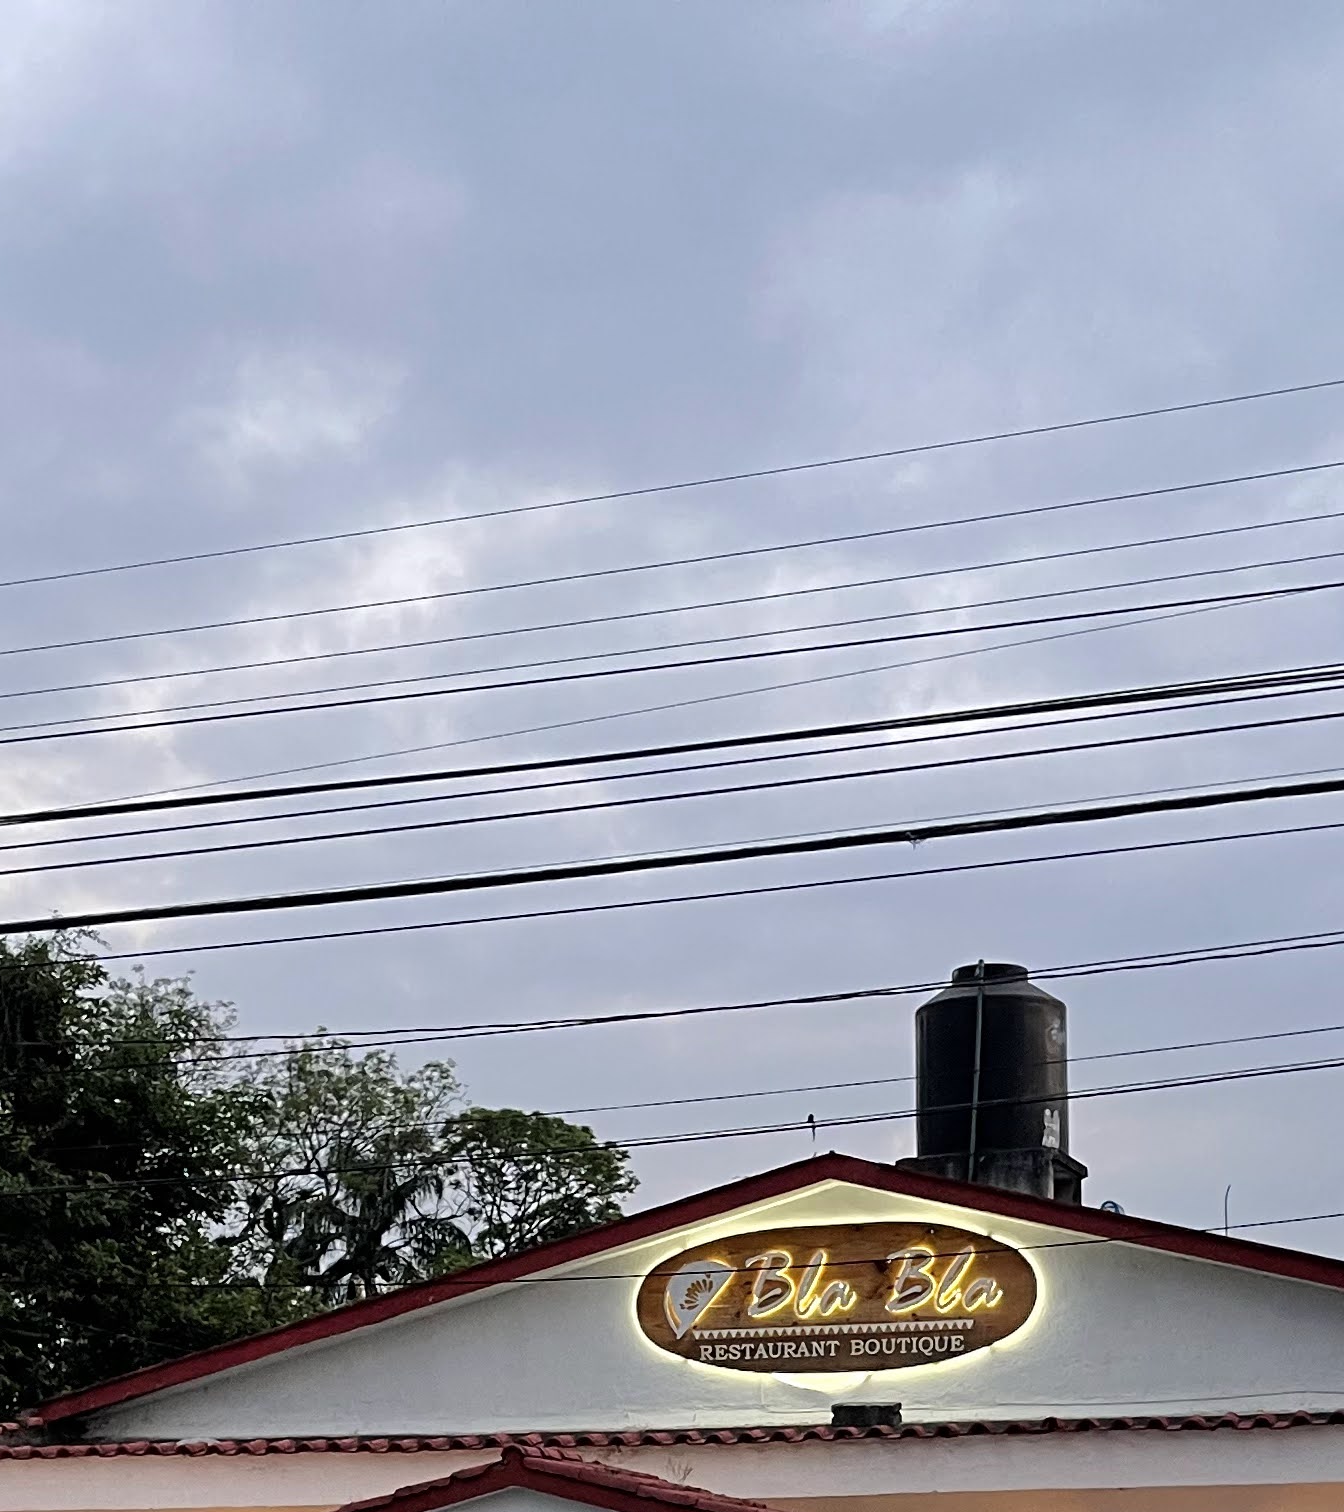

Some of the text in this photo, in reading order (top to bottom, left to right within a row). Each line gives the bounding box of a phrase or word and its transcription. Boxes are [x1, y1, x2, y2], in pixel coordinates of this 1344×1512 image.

[744, 1245, 1004, 1319] Bla Bla
[699, 1334, 966, 1362] RESTAURANT BOUTIQUE
